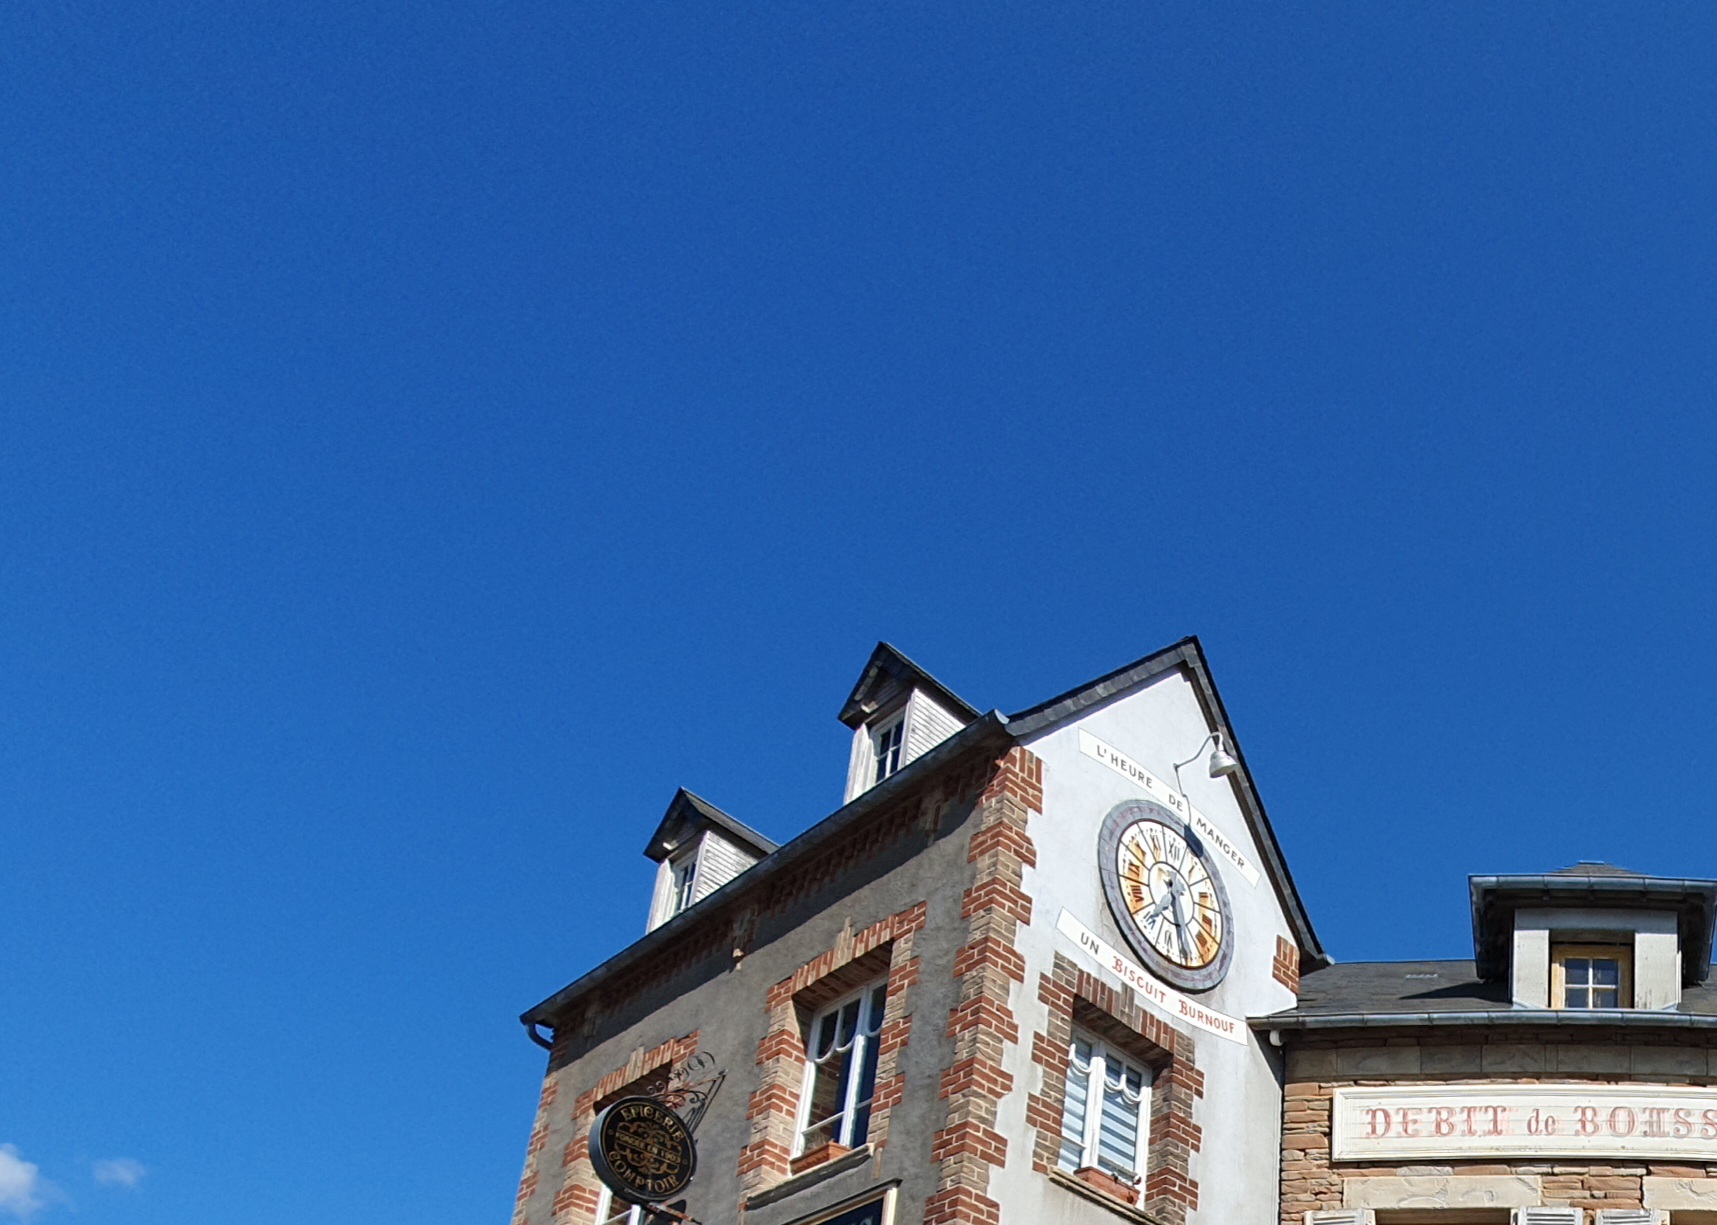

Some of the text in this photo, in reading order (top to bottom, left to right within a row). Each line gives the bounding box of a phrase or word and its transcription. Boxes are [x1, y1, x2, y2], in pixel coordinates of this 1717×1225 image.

[1096, 744, 1246, 870] L'HEURE DE MANGER
[1080, 931, 1236, 1034] UN BISCUIT BURNOUF
[621, 1106, 684, 1141] EPICERIE
[1365, 1105, 1508, 1138] DEBIT
[1526, 1108, 1557, 1136] de
[608, 1151, 679, 1192] COMPTOIR
